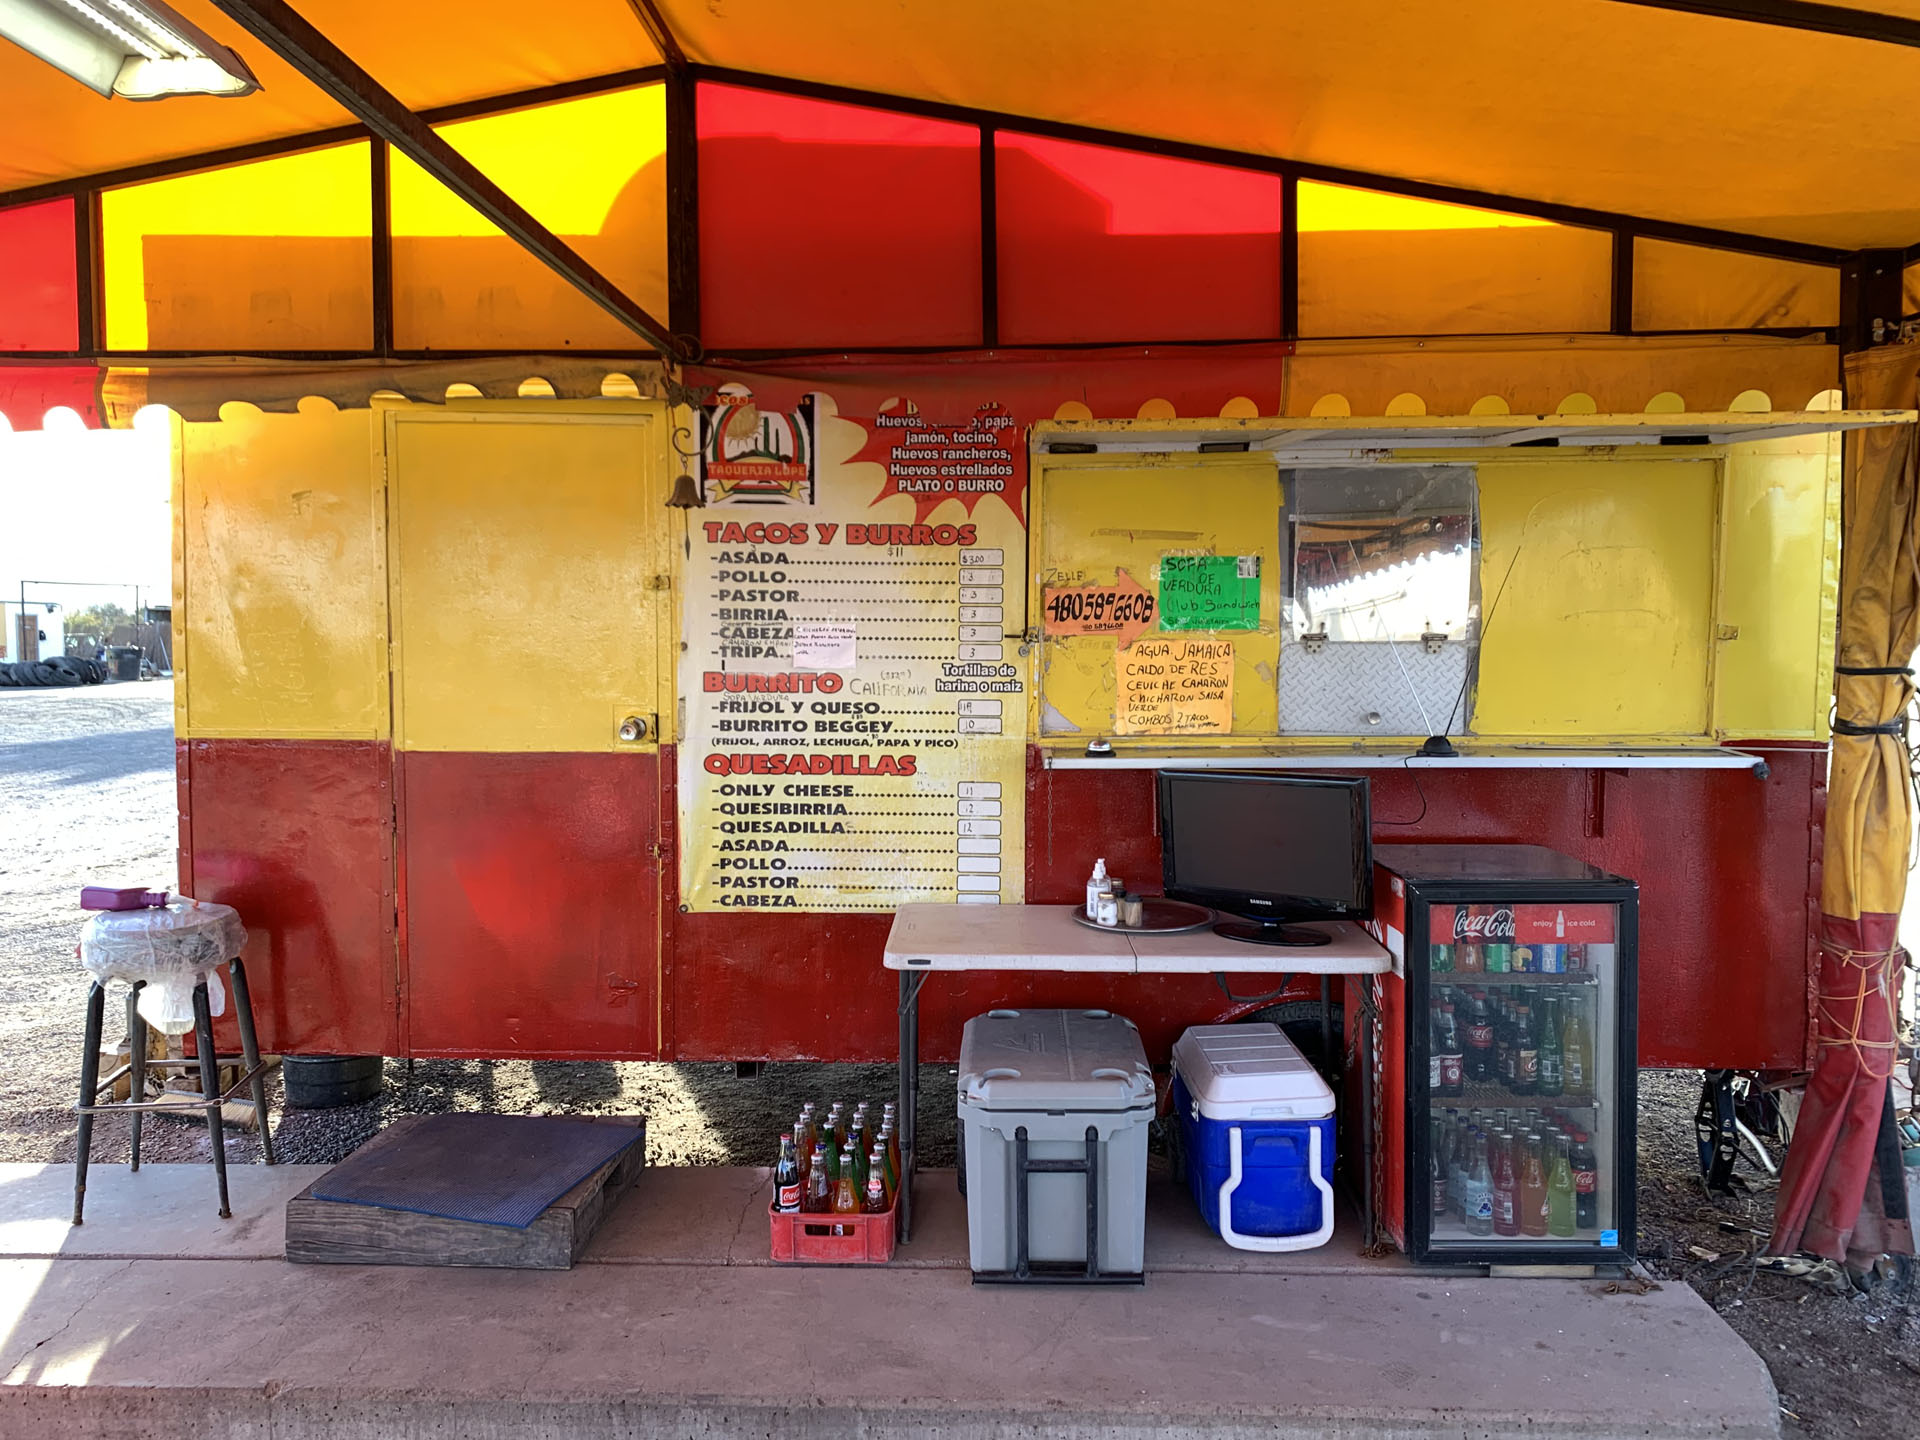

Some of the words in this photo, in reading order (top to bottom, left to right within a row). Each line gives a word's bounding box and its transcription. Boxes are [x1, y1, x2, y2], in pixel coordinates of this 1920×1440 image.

[905, 430, 949, 445] jamón,
[953, 431, 997, 444] tocino,
[892, 448, 938, 460] Huevos
[942, 448, 1011, 460] rancheros,
[890, 464, 937, 476] Huevos
[941, 464, 1012, 476] estrellados
[898, 480, 940, 492] PLATO
[944, 480, 954, 492] O
[958, 480, 1004, 492] BURRO
[703, 522, 809, 544] TACOS
[815, 523, 839, 544] Y
[846, 524, 977, 546] BURROS
[1200, 573, 1215, 585] DE
[1163, 579, 1222, 596] VERDURA
[1047, 592, 1155, 623] 4805896608
[1175, 642, 1231, 661] JAMAICA
[942, 663, 997, 677] Tortillas
[998, 664, 1016, 677] de
[1126, 664, 1164, 676] CALDO
[1169, 664, 1188, 674] DE
[1189, 660, 1218, 676] RES
[703, 672, 844, 694] BURRITO
[935, 679, 979, 692] harina
[980, 682, 988, 692] o
[990, 680, 1023, 692] maiz
[791, 702, 804, 714] Y
[811, 702, 880, 715] QUESO
[1128, 703, 1158, 712] VERDE
[1128, 714, 1172, 726] COMBOS
[1177, 712, 1184, 722] 2
[1186, 714, 1209, 723] TACOS
[814, 720, 894, 733] BEGGEY
[712, 738, 760, 748] (FRIJOL,
[764, 738, 810, 747] ARROZ,
[814, 738, 874, 748] LECHUGA,
[877, 739, 910, 747] PAPA
[925, 739, 958, 749] PICO)
[704, 753, 917, 777] QUESADILLAS
[783, 785, 854, 798] CHEESE
[1454, 909, 1516, 939] Coca-Cola
[1533, 920, 1553, 928] enjoy
